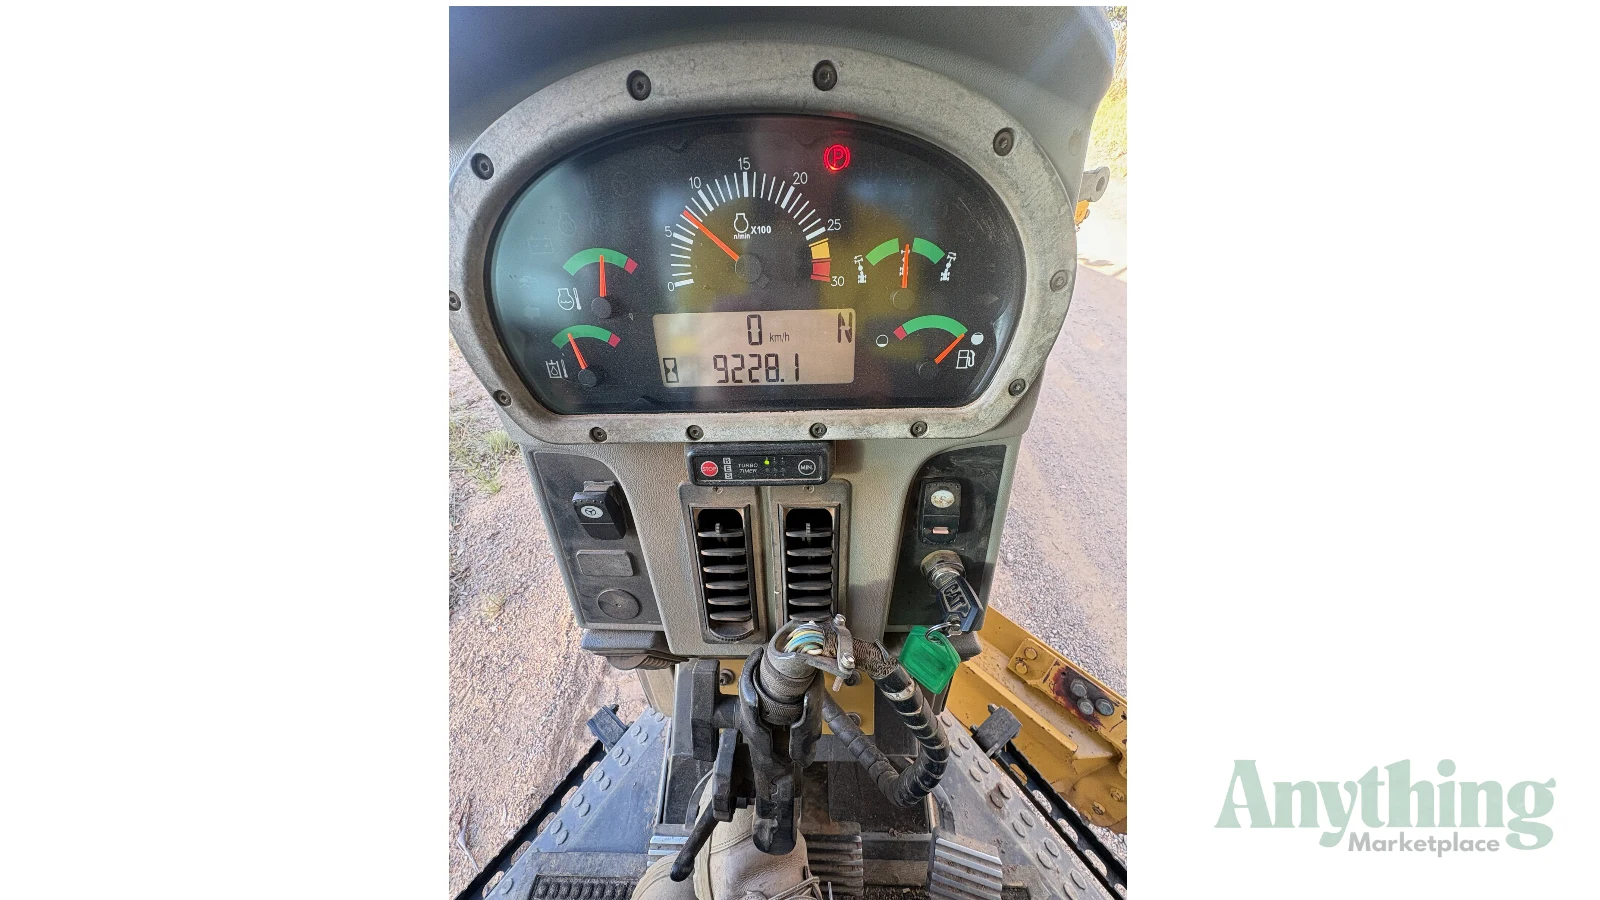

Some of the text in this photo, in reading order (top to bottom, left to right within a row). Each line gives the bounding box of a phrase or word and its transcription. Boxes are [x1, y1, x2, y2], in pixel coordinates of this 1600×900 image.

[738, 157, 750, 170] 15
[688, 176, 702, 189] 10
[793, 172, 808, 185] 20
[751, 225, 772, 235] X100
[827, 218, 842, 231] 25
[664, 225, 673, 238] 5
[733, 232, 751, 240] n/min
[667, 281, 675, 292] 0
[830, 275, 845, 287] 30
[746, 313, 790, 346] 0 km/h
[837, 311, 853, 343] N
[712, 352, 800, 383] 9228.1
[944, 583, 967, 609] CAT
